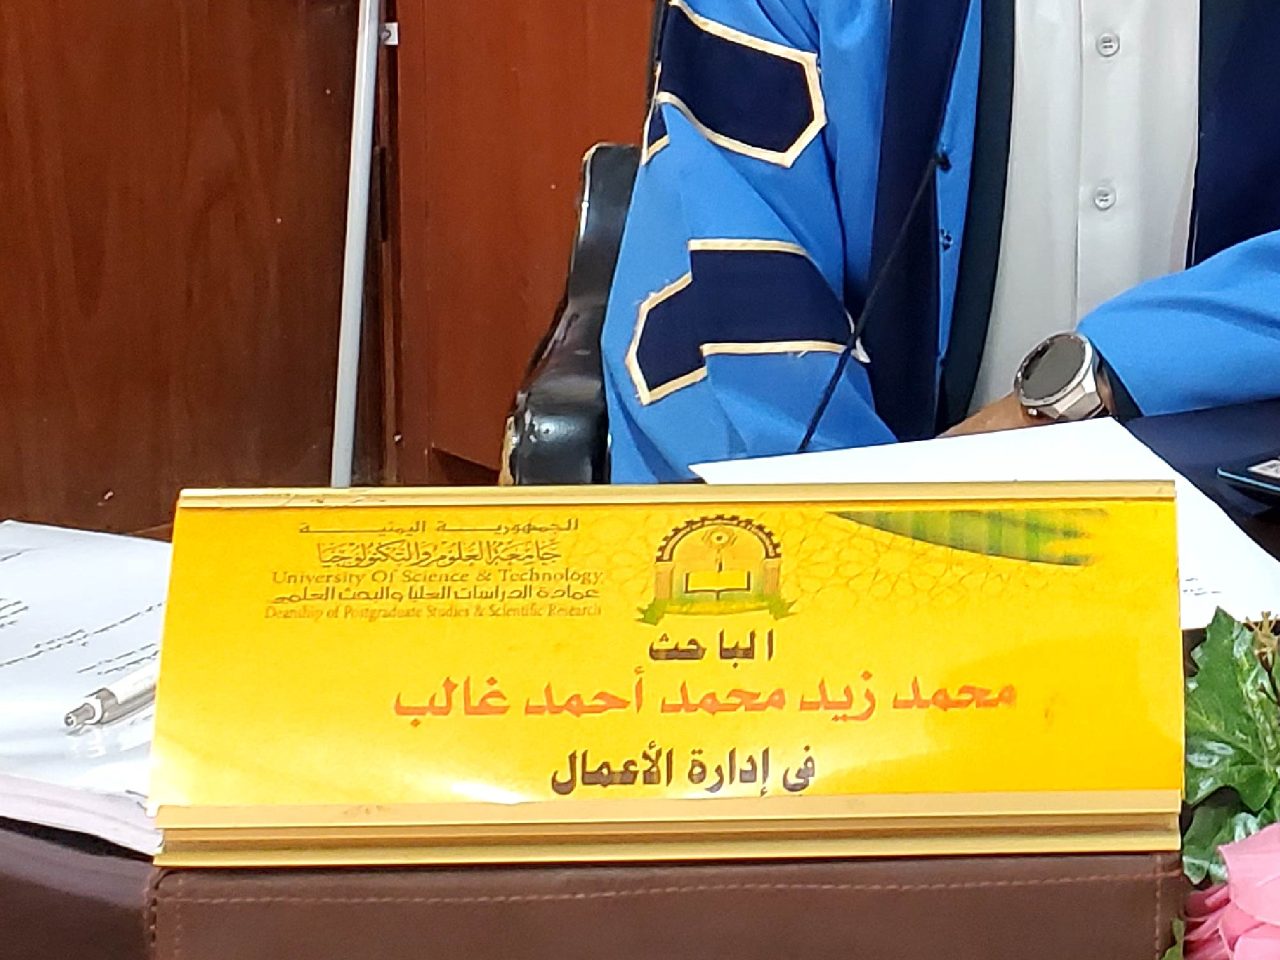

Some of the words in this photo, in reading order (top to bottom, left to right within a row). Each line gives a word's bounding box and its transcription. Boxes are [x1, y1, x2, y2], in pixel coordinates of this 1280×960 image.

[272, 571, 367, 586] University
[372, 570, 397, 584] Of
[402, 570, 469, 584] Science
[476, 570, 492, 582] &
[498, 568, 603, 586] Technology
[426, 604, 469, 618] Studies
[549, 603, 602, 617] Research
[649, 628, 774, 668] الباحث
[394, 675, 509, 728] غالب
[524, 667, 643, 717] أحمد
[661, 680, 786, 714] محمد
[800, 670, 877, 724] زيد
[893, 676, 1017, 710] محمد
[550, 741, 673, 795] الأعمال
[687, 746, 769, 797] إدارة
